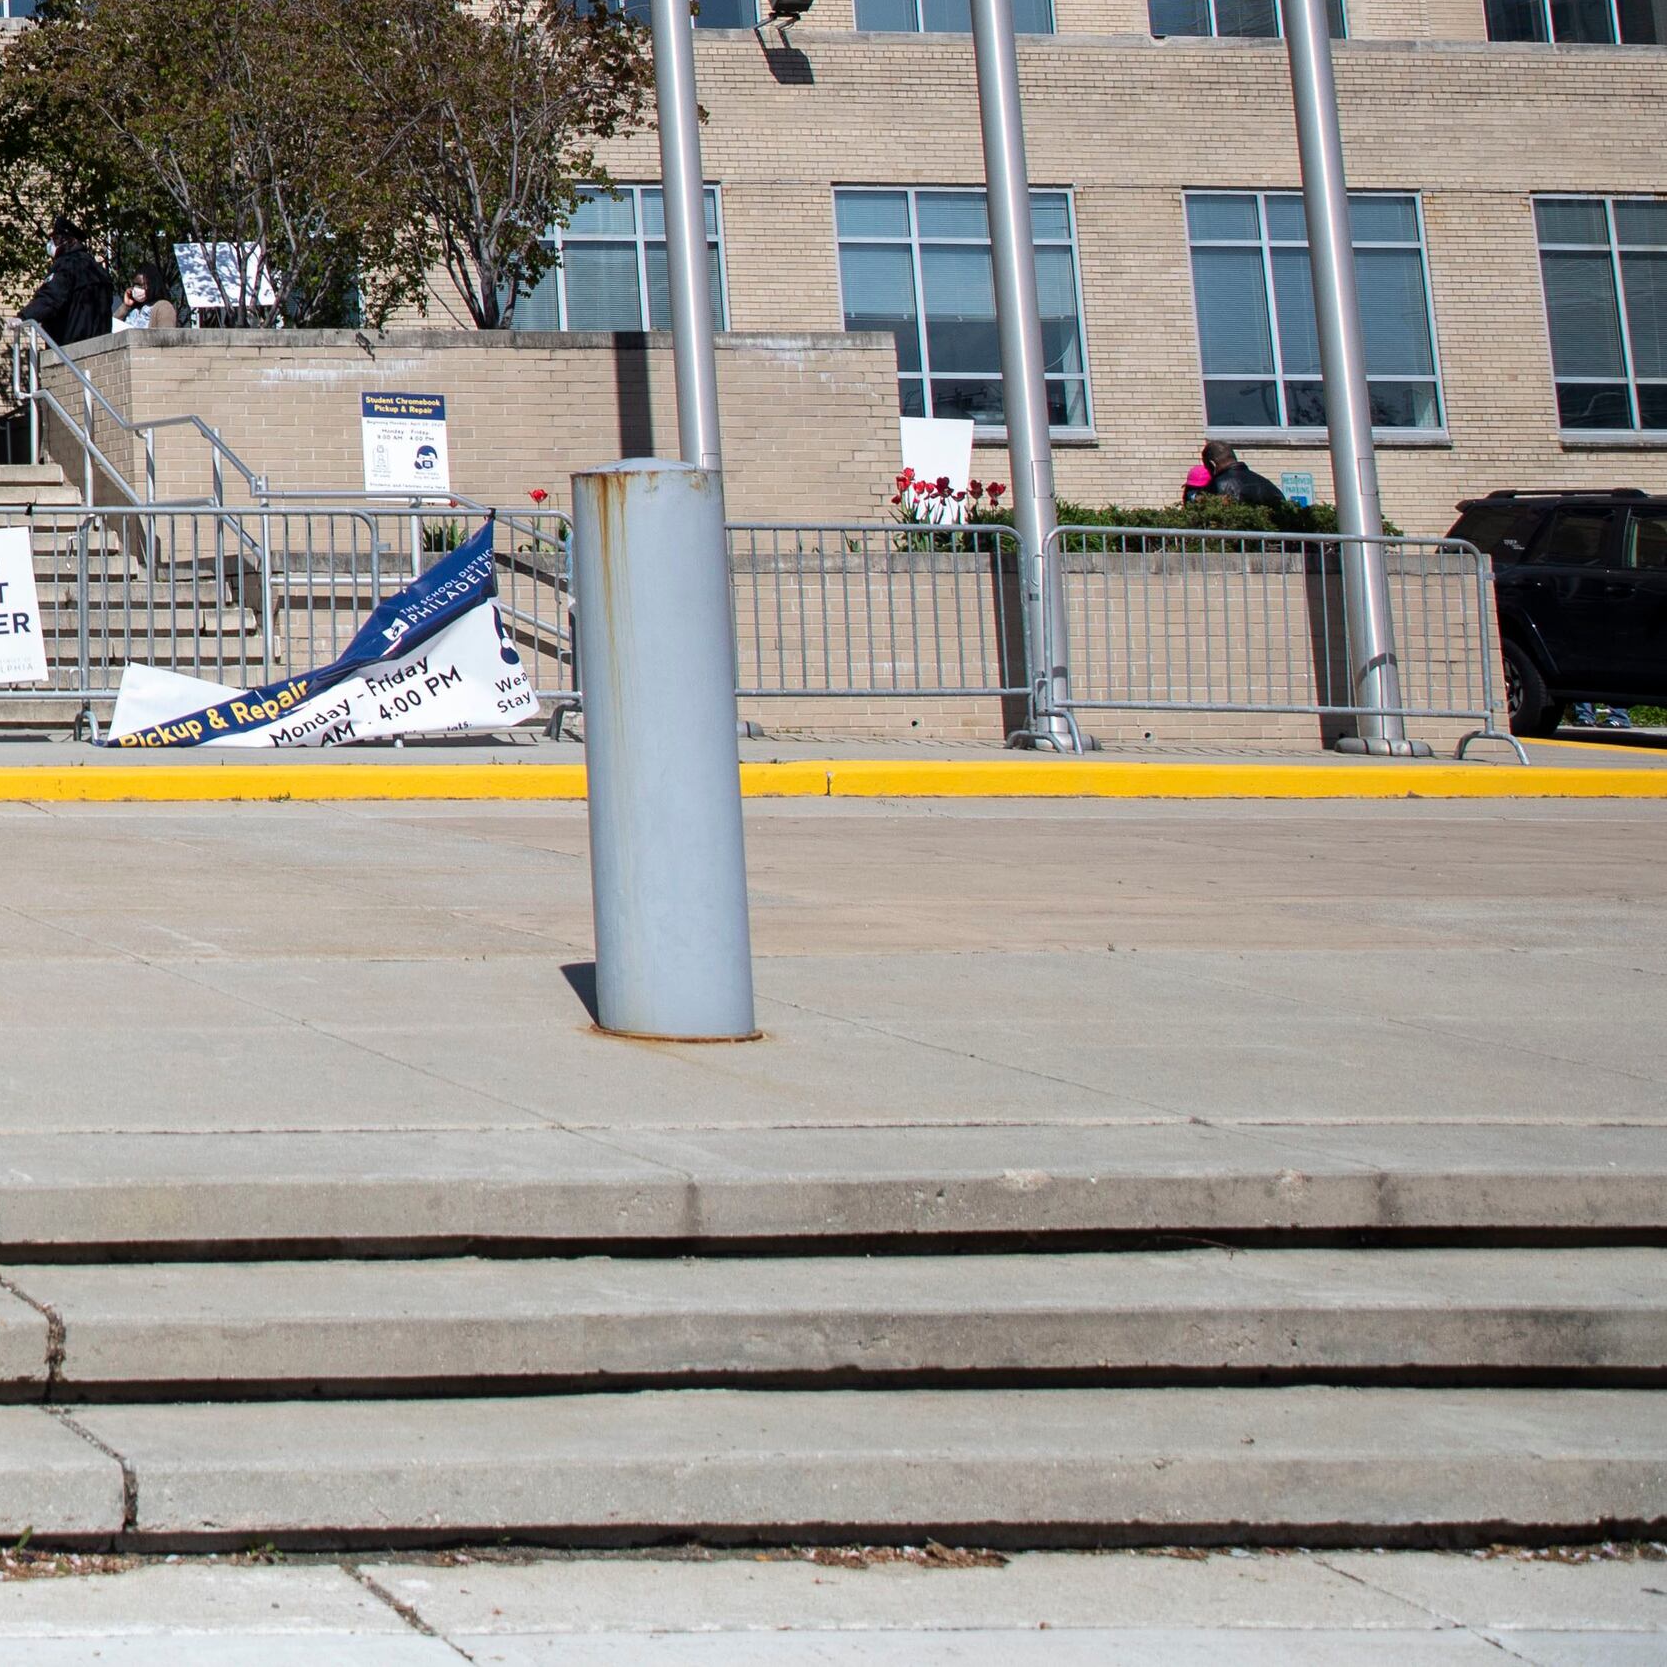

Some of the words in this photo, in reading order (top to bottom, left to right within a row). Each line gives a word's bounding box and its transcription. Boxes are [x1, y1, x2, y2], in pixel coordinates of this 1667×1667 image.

[366, 396, 394, 405] Student
[395, 397, 441, 407] Chromebook
[374, 404, 399, 414] Pickup
[409, 406, 433, 415] Repair
[400, 604, 419, 615] THE
[420, 579, 458, 605] SCHOOL
[458, 548, 493, 578] DISTRIC
[119, 720, 203, 747] Pickup
[206, 706, 229, 729] &
[230, 679, 308, 724] Repair
[269, 698, 351, 747] Monday
[365, 656, 428, 697] Friday
[320, 720, 356, 747] AM
[379, 690, 422, 721] 4:00
[424, 664, 463, 697] PM
[497, 691, 531, 713] Stay
